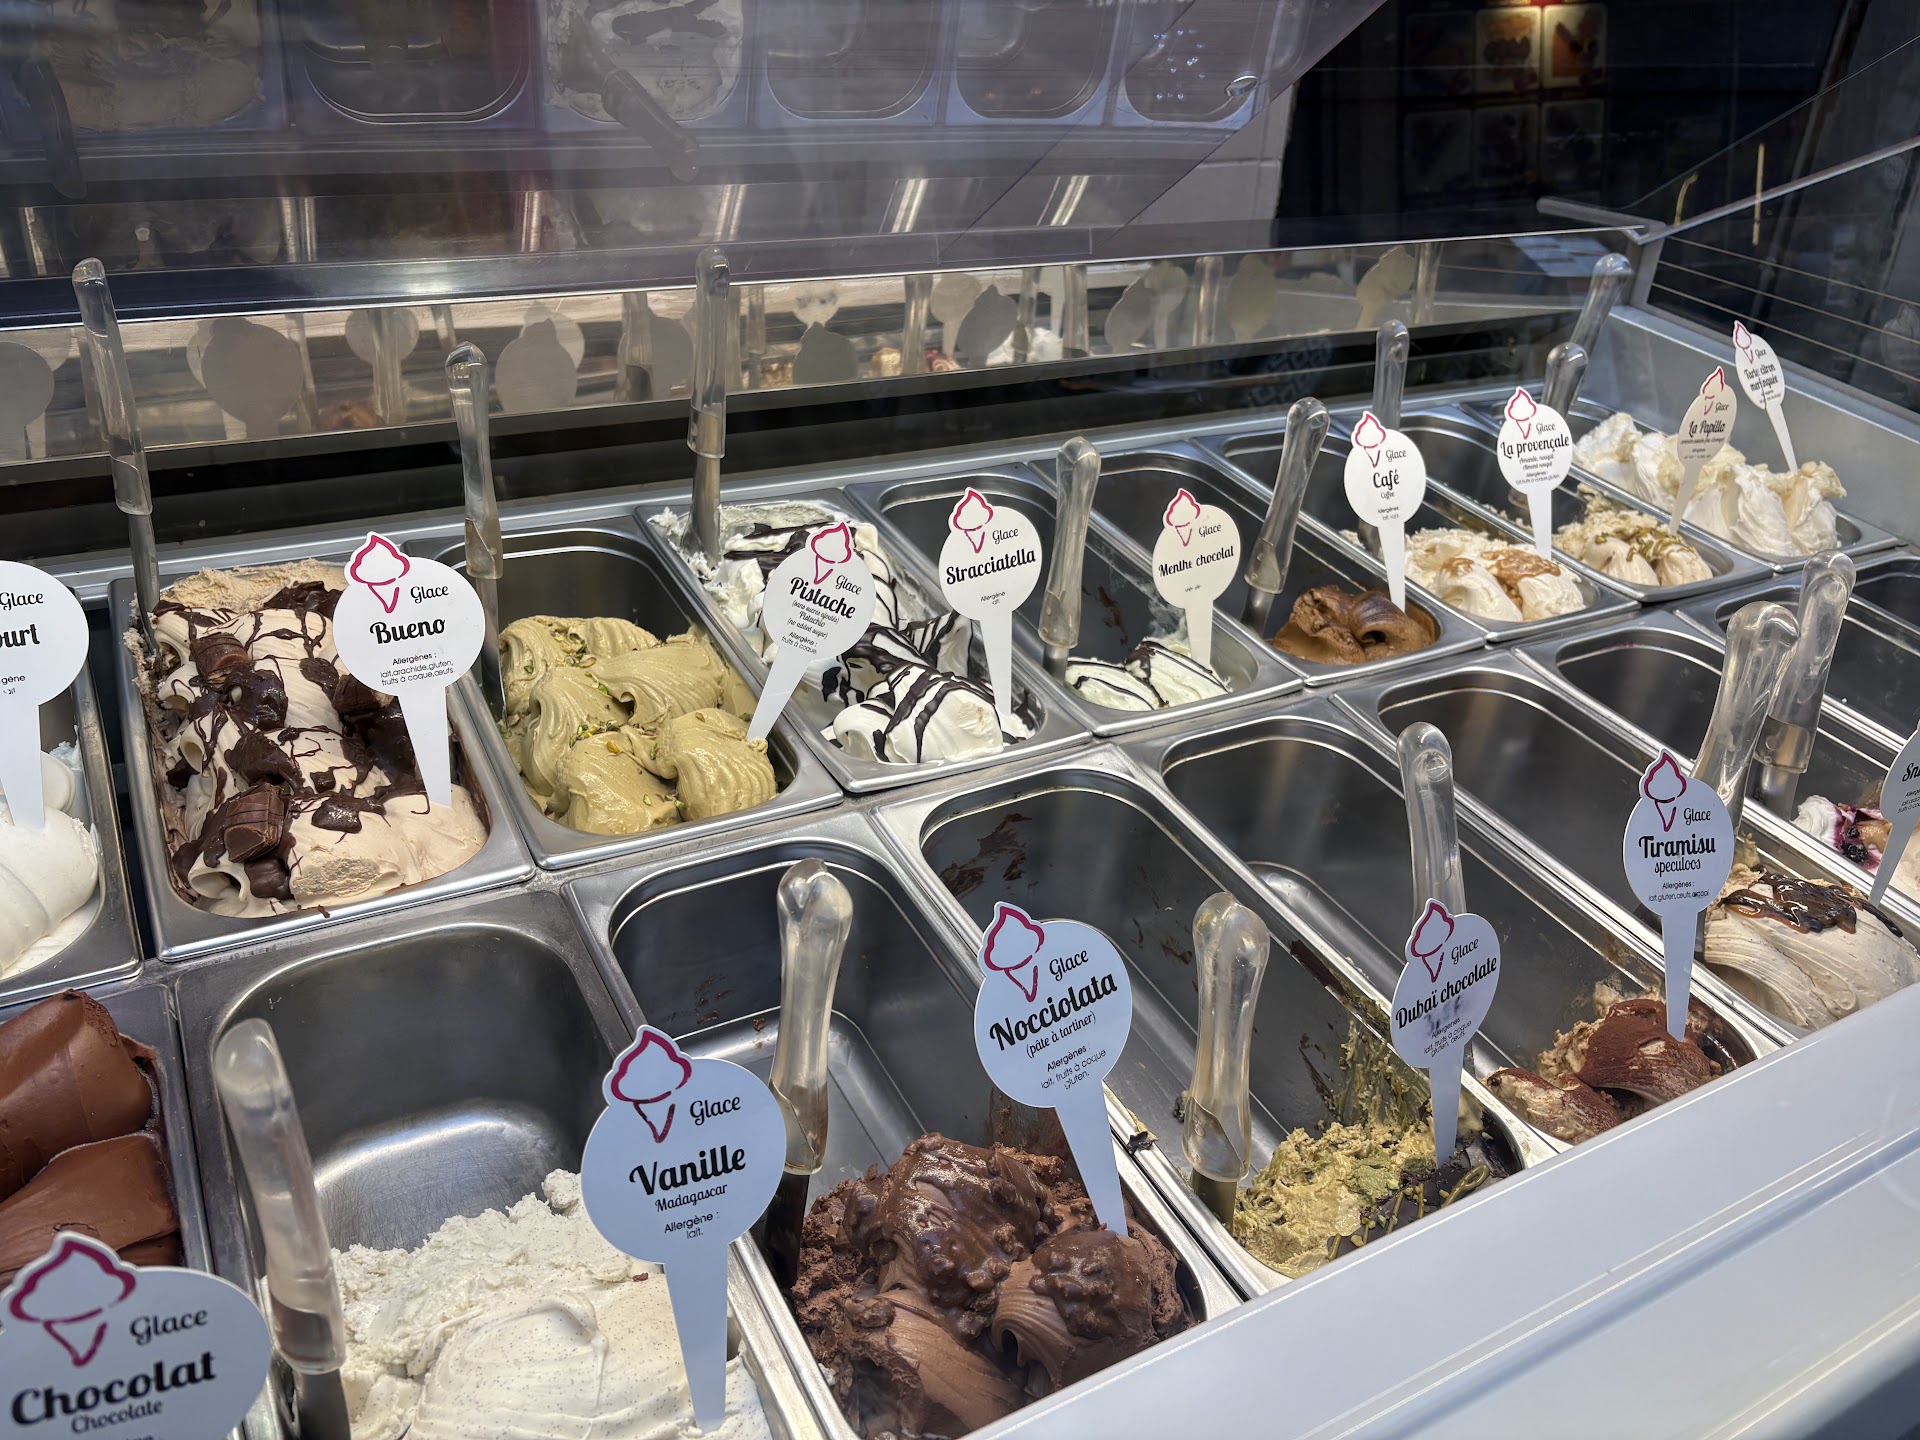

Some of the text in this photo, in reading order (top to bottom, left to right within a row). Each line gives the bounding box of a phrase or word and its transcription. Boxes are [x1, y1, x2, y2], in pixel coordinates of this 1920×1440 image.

[1535, 422, 1556, 435] Glace
[1688, 420, 1698, 438] La
[1386, 449, 1407, 462] Glace
[1500, 433, 1570, 459] La provençale
[1373, 468, 1400, 491] Café
[992, 528, 1019, 545] Glace
[1198, 524, 1222, 538] Glace
[946, 548, 1036, 585] Stracciatella
[1158, 559, 1193, 577] Menthe
[410, 585, 449, 604] Glace
[789, 577, 856, 619] Pistache
[835, 574, 862, 596] Glace
[0, 591, 44, 611] Glace
[369, 618, 446, 644] Bueno
[796, 621, 812, 632] added
[799, 611, 826, 628] Pistachio
[381, 676, 399, 687] fruits
[400, 673, 406, 683] à
[1683, 807, 1712, 826] Glace
[1638, 833, 1716, 859] Tiramisu
[1654, 857, 1702, 878] speculoos
[1451, 938, 1479, 965] Glace
[1049, 950, 1089, 982] Glace
[1395, 989, 1439, 1030] Dubaï
[1440, 957, 1497, 1003] chocolate
[989, 973, 1118, 1051] Nocciolata
[1026, 1010, 1097, 1059] (pâte à tartiner)
[1047, 1044, 1087, 1073] Allergènes
[1055, 1067, 1073, 1082] fruits
[1074, 1062, 1081, 1072] à
[1081, 1049, 1107, 1068] coque
[689, 1096, 742, 1126] Glace
[628, 1144, 747, 1196] Vanille
[654, 1184, 728, 1213] Madagascar
[664, 1212, 714, 1234] Allergène
[129, 1309, 208, 1346] Glace
[11, 1351, 217, 1427] Chocolat
[71, 1399, 164, 1434] Chocolate
